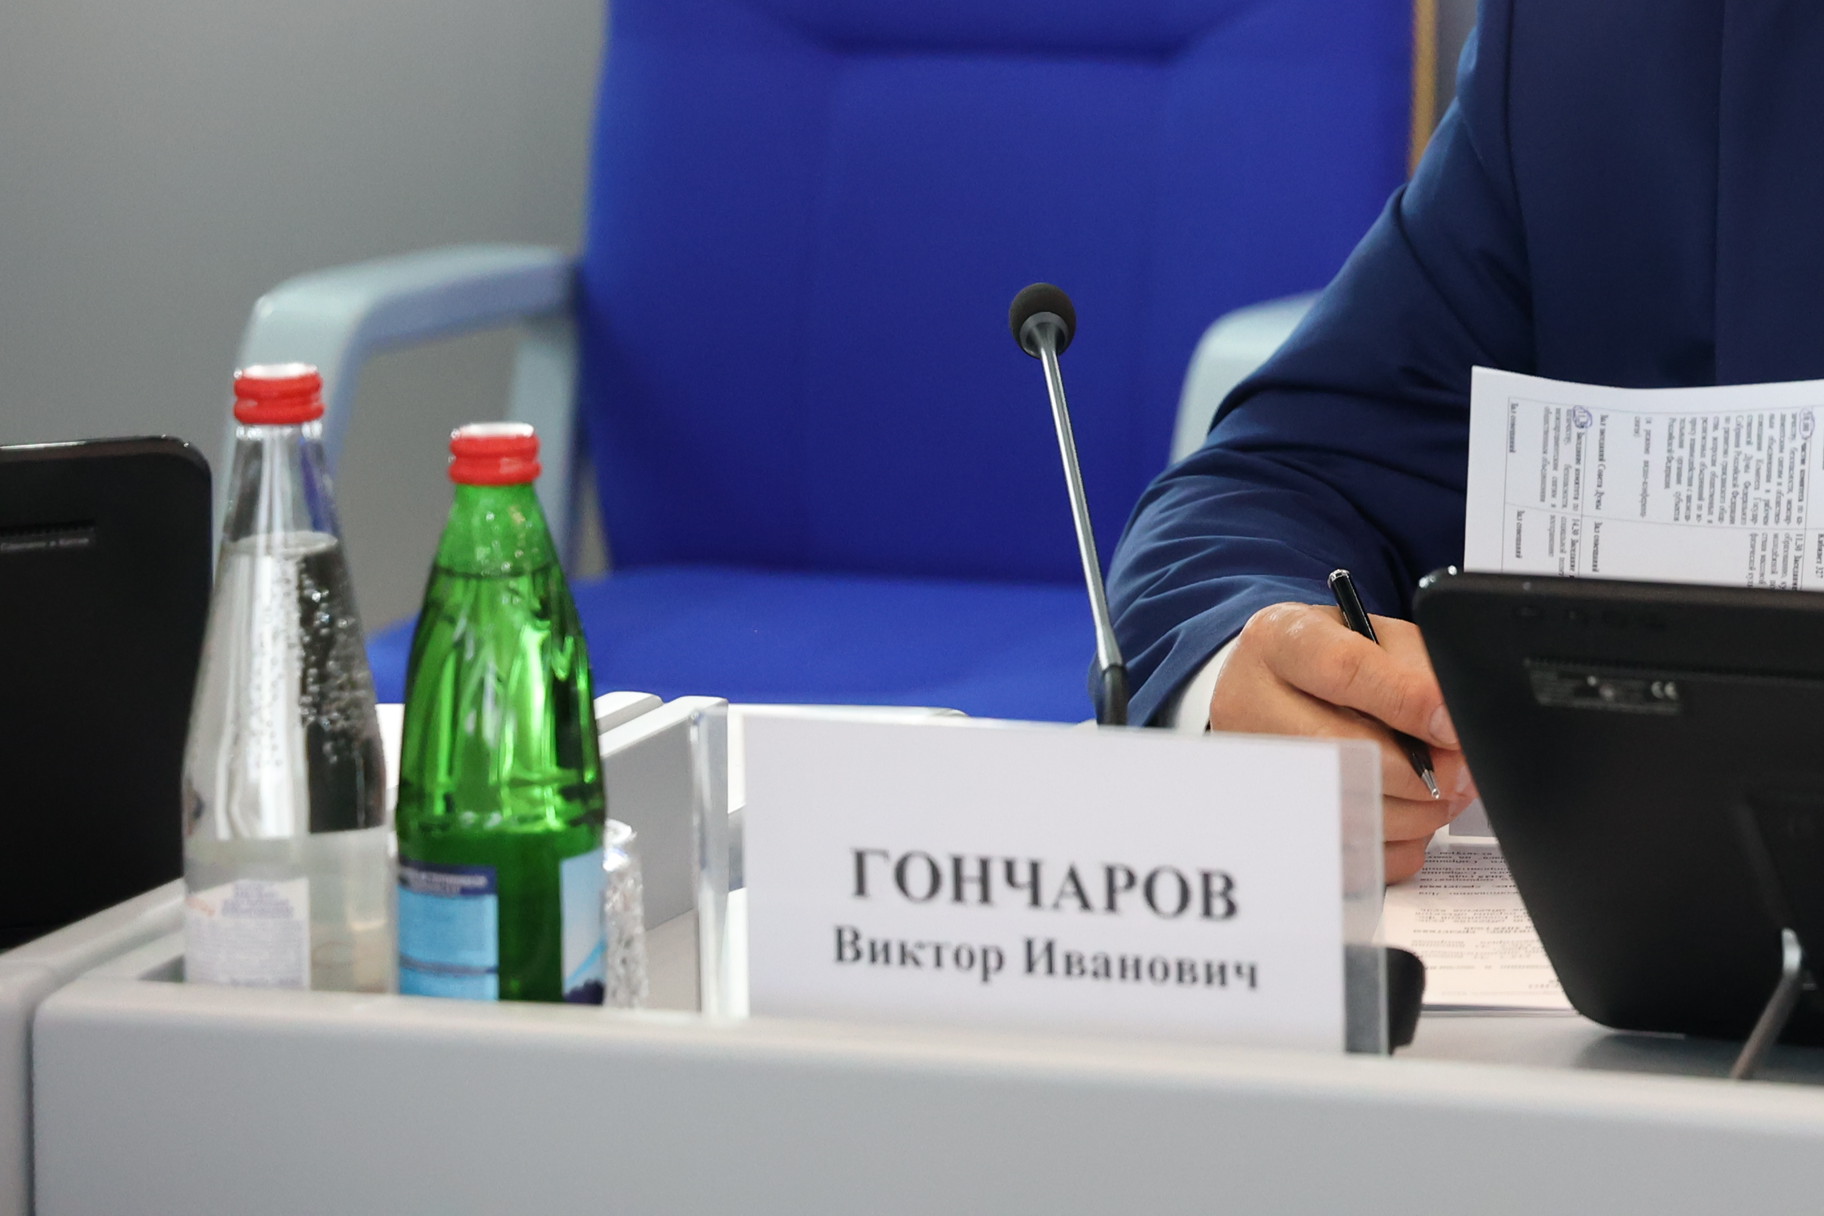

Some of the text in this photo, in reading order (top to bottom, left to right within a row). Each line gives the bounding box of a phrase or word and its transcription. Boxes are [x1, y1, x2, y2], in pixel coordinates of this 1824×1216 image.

[1596, 463, 1606, 488] Совета
[1594, 489, 1605, 510] Думы
[1594, 521, 1603, 534] Зал
[849, 847, 1241, 923] ГОНЧАРОВ
[832, 924, 1259, 990] Виктор Иванович
